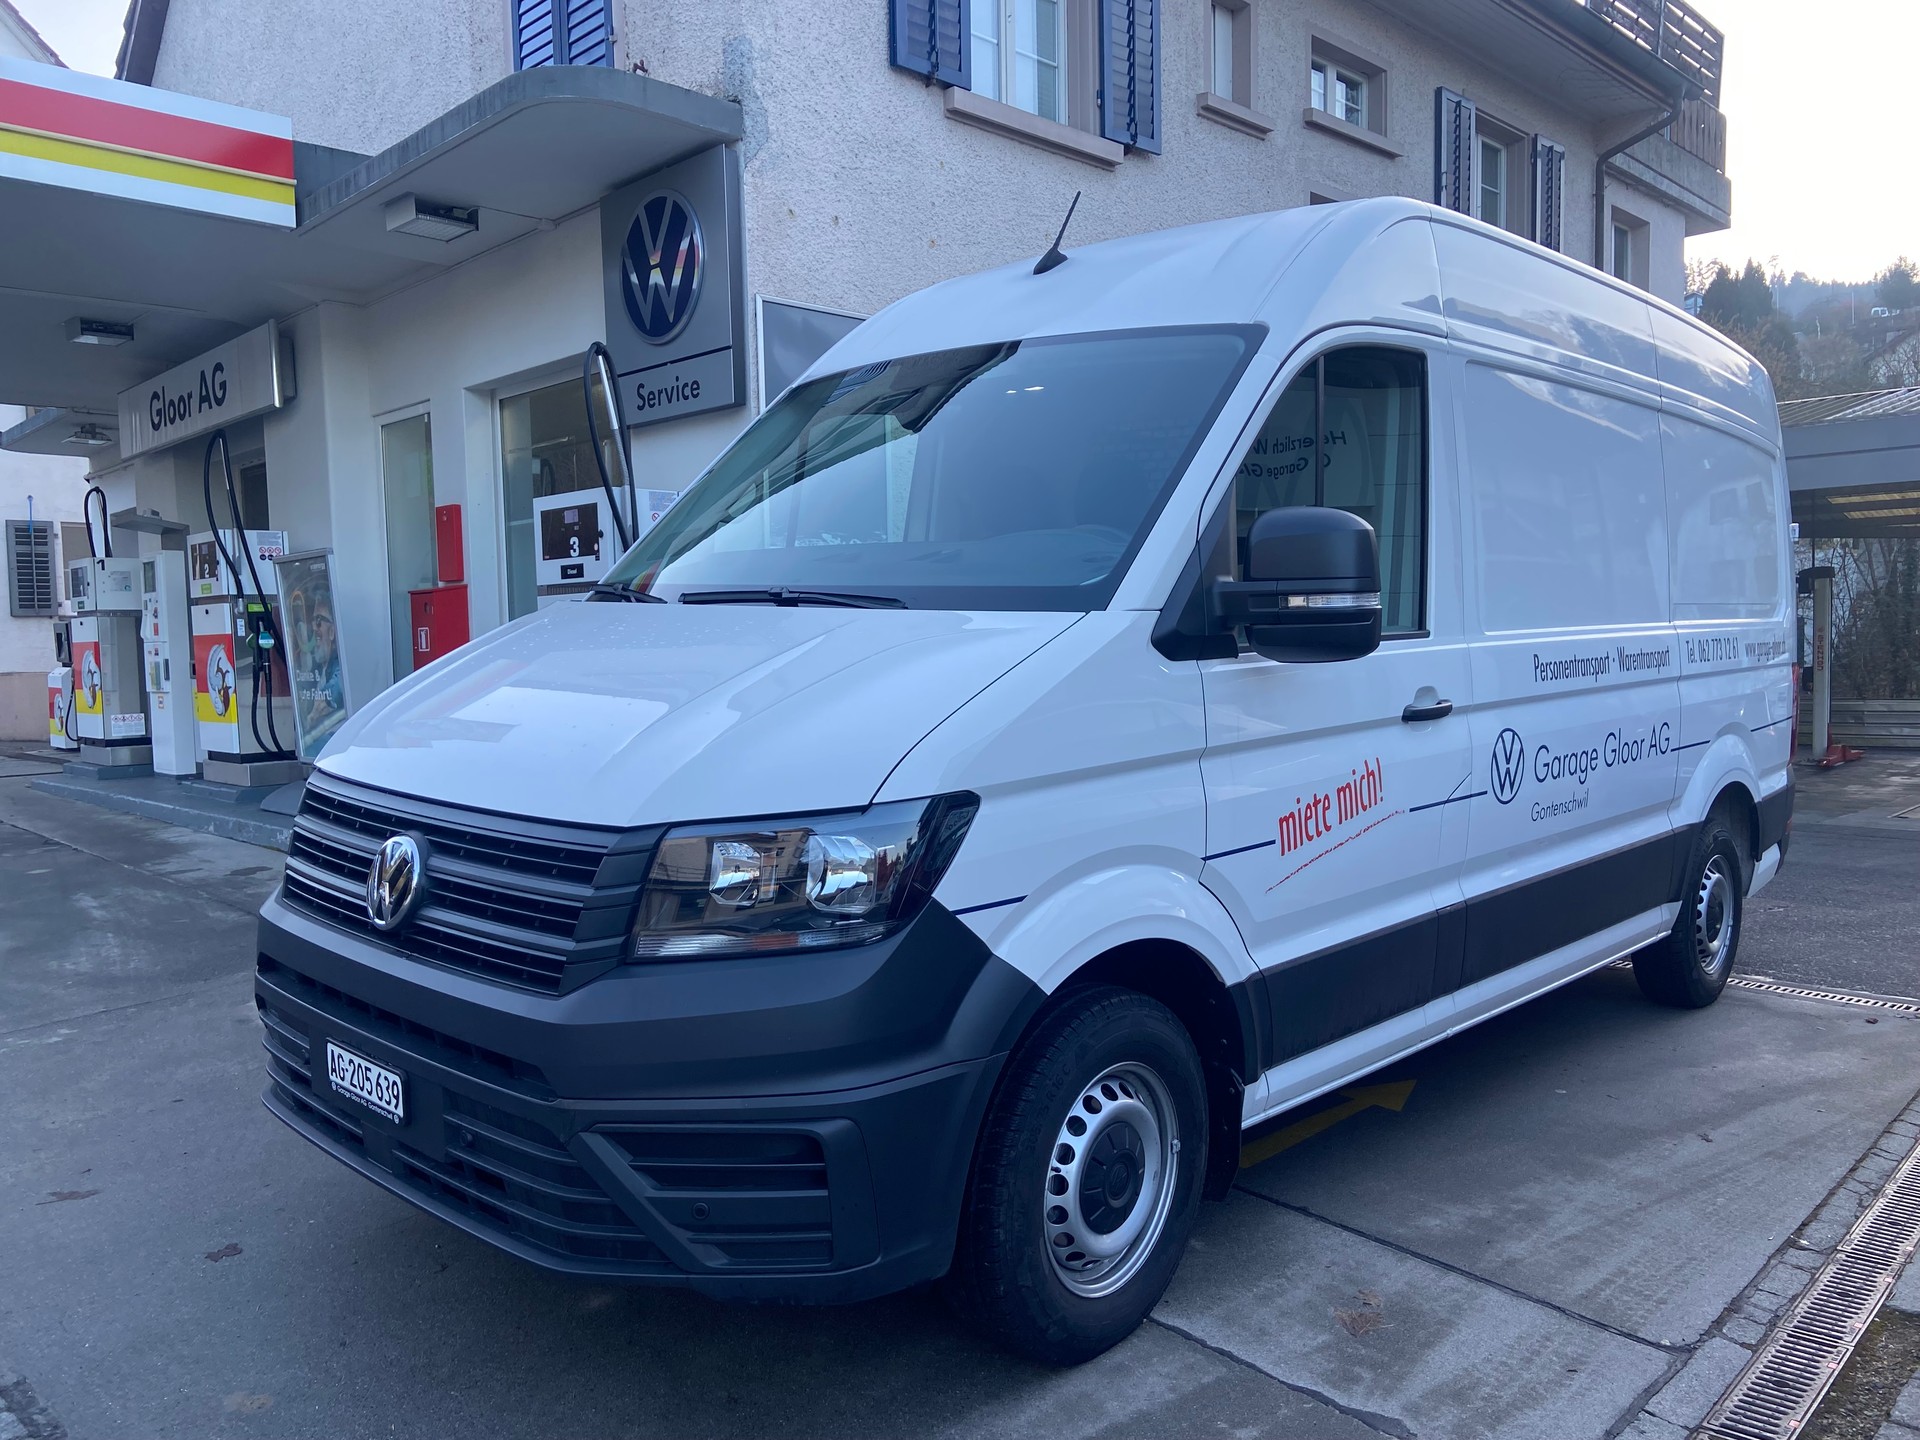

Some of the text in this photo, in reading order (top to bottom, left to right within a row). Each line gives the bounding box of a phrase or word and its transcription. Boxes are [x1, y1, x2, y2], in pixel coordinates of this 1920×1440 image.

[150, 362, 227, 431] Gloor AG
[636, 375, 701, 411] Service
[96, 559, 105, 571] 1
[569, 536, 580, 558] 3
[204, 563, 210, 578] 2
[1533, 651, 1611, 682] Personentransport
[1616, 645, 1671, 674] Warentransport
[1685, 638, 1698, 664] Tel.
[1698, 639, 1711, 662] 062
[1711, 637, 1723, 661] 773
[1724, 637, 1732, 660] 12
[1534, 744, 1599, 785] Garage
[1603, 727, 1646, 767] Gloor
[1647, 721, 1671, 758] AG
[1278, 757, 1385, 857] miete mich!
[1531, 788, 1590, 822] Gontenschwil
